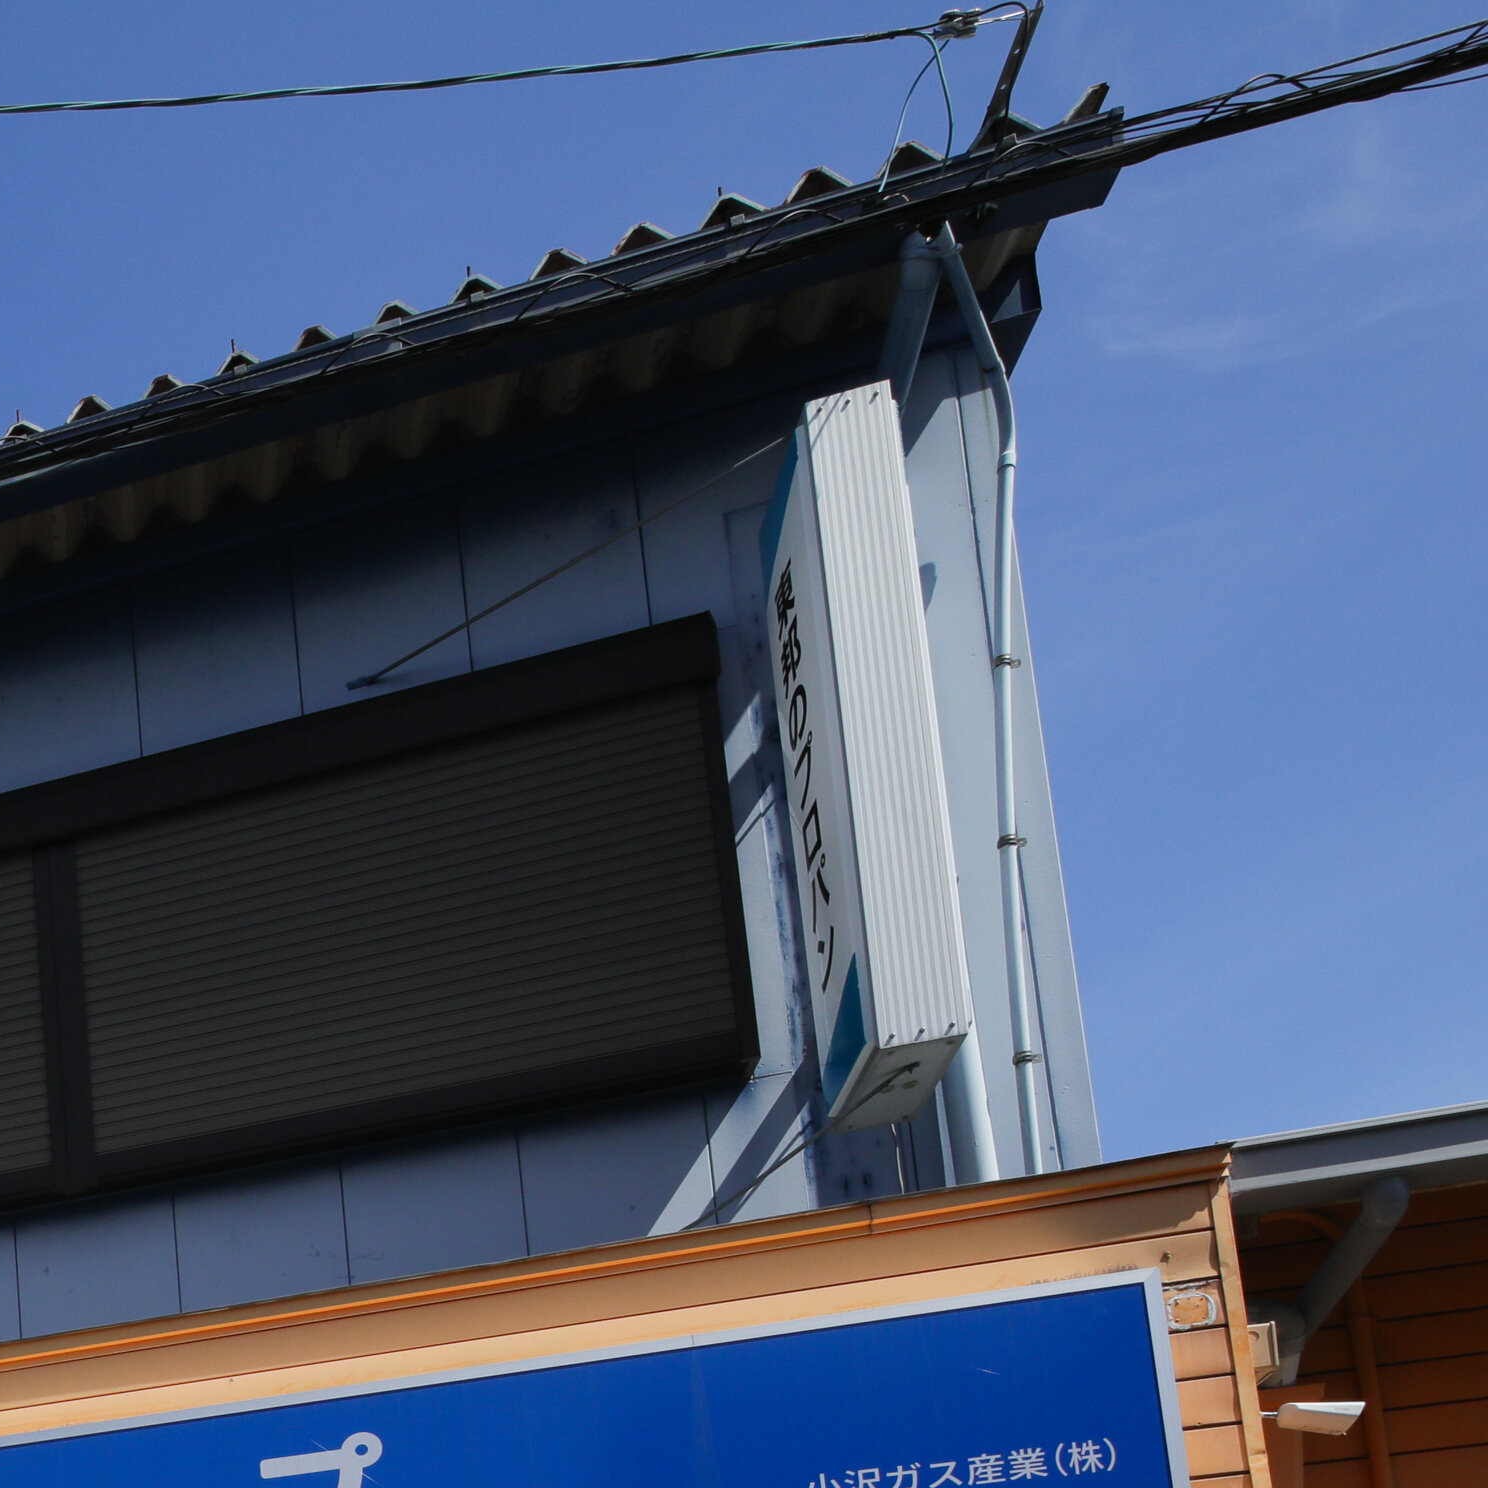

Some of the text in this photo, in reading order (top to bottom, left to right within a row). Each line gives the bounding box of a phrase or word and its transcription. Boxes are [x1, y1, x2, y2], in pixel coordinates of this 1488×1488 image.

[774, 557, 836, 994] 東邦のプロパン
